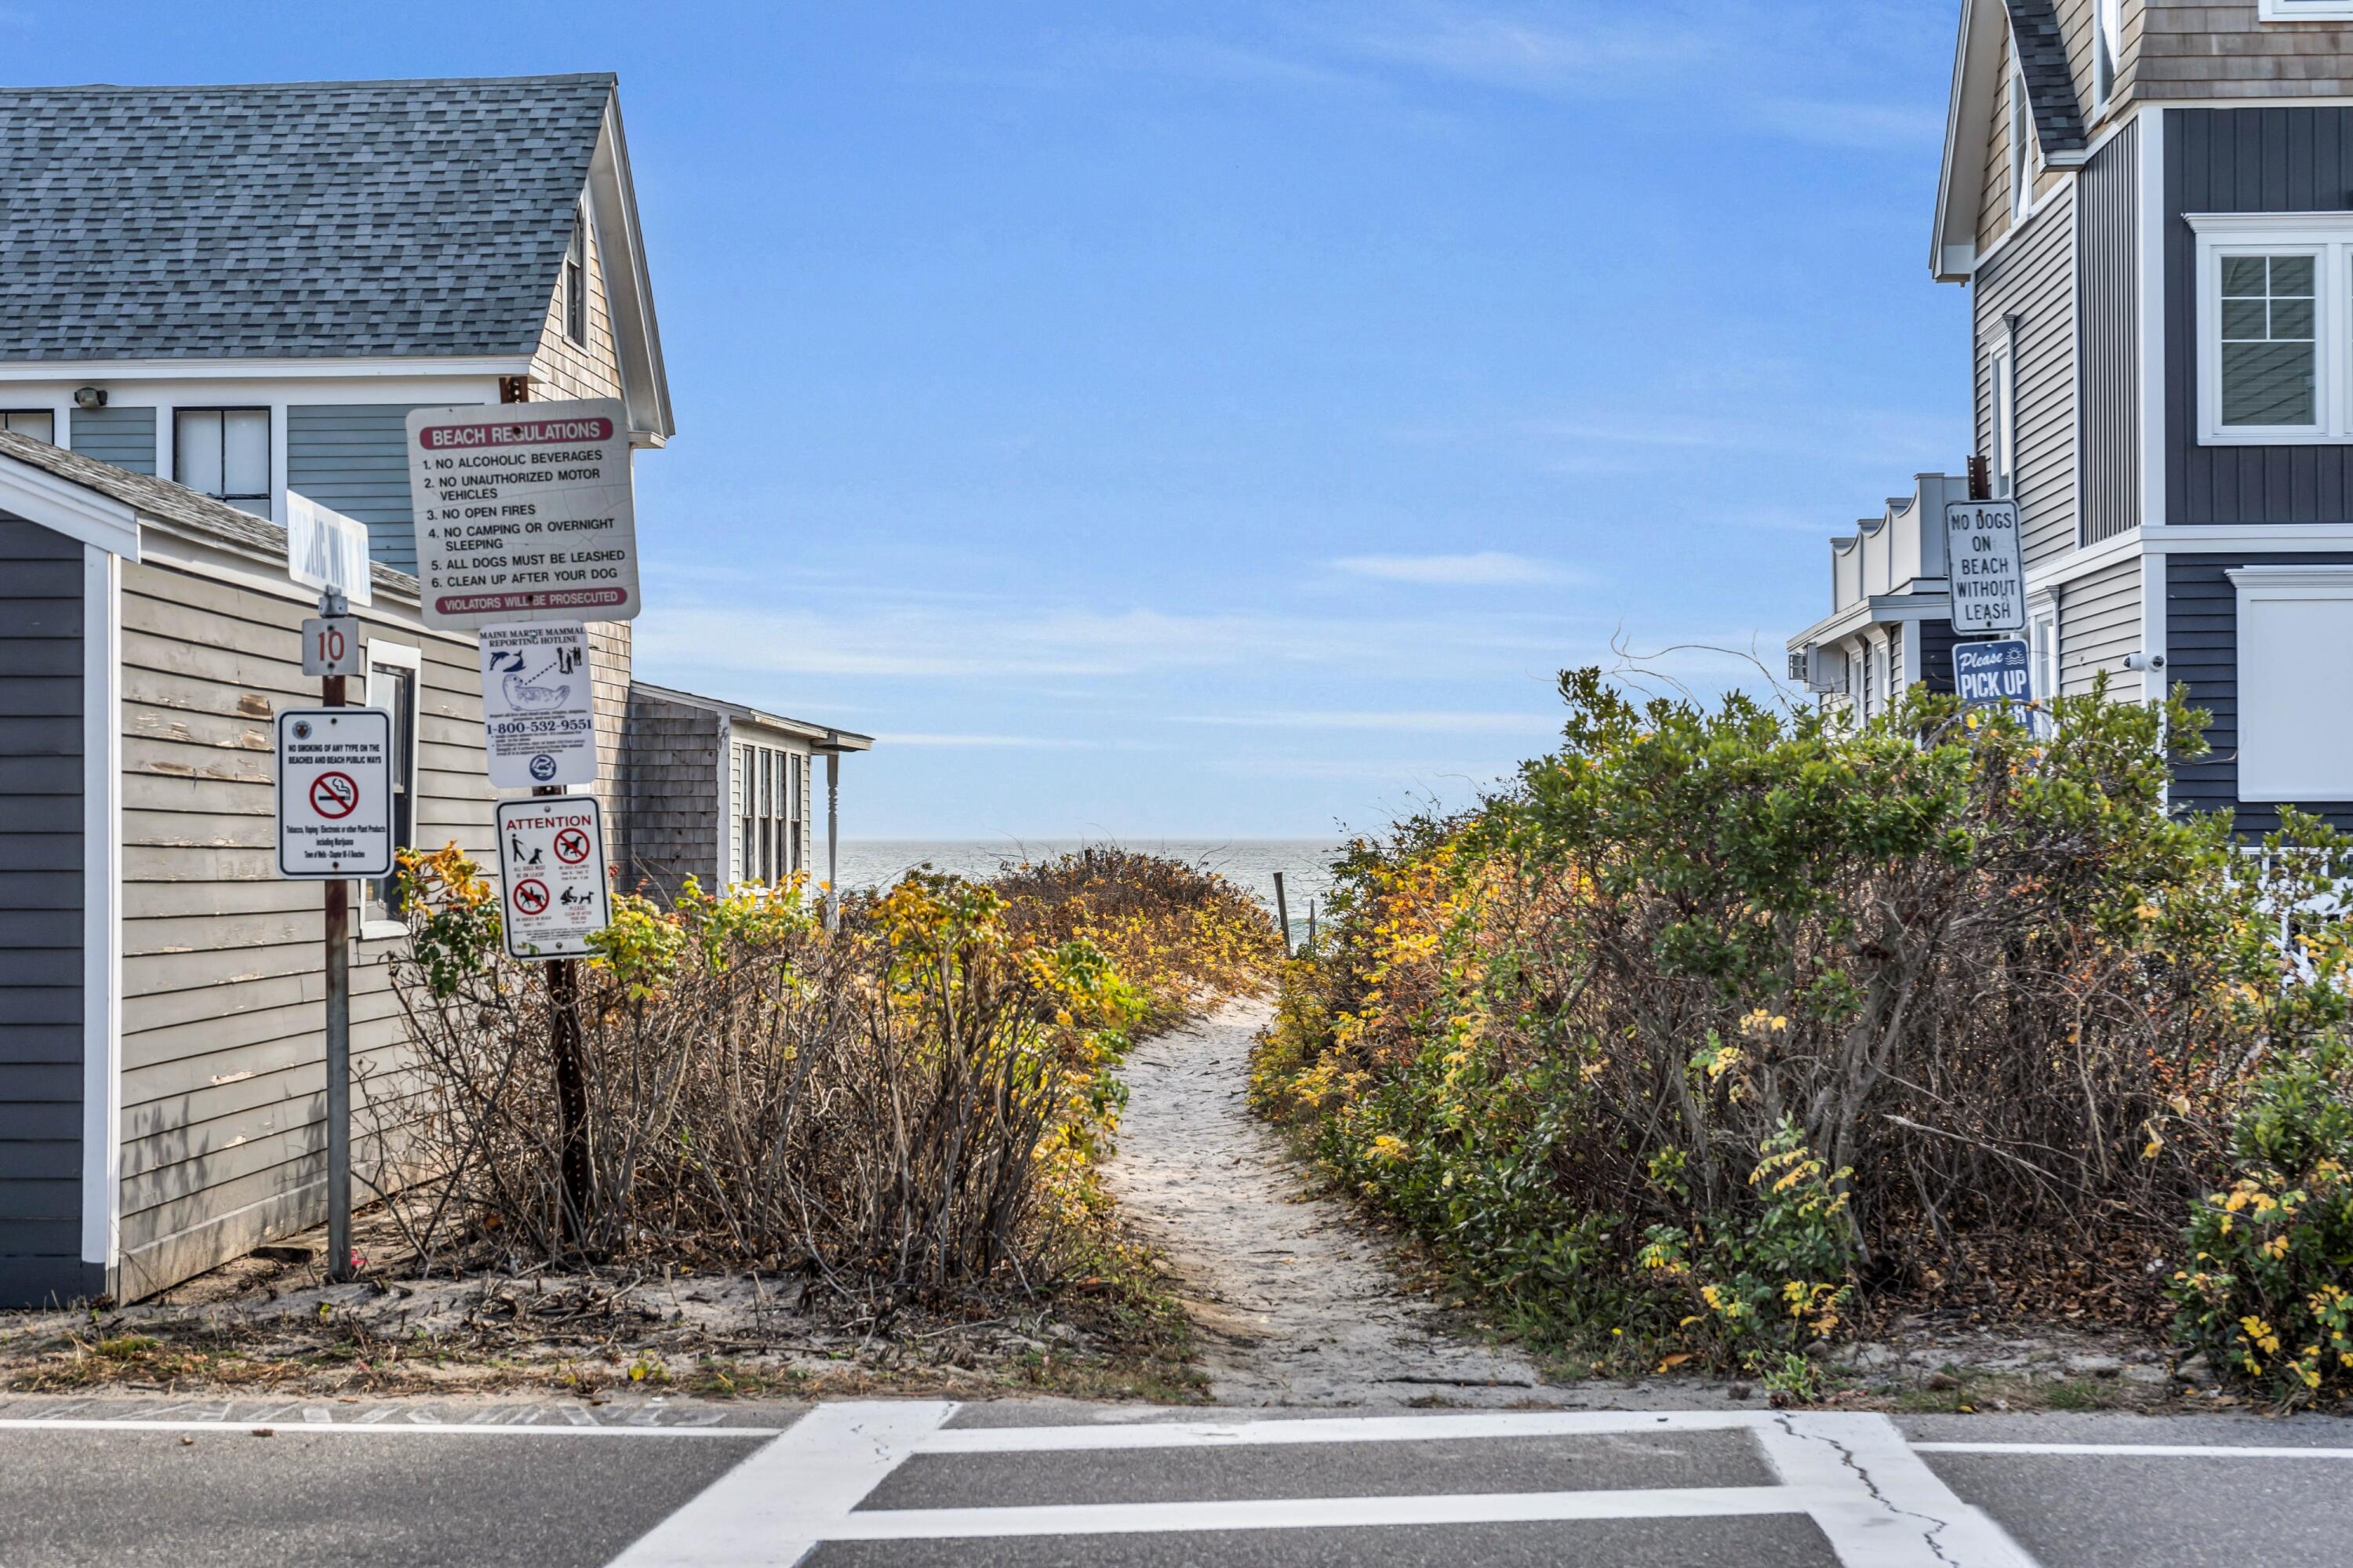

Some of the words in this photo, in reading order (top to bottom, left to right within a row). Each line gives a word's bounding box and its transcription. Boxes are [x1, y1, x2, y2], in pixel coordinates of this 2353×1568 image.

[433, 428, 486, 446] BEACH
[491, 421, 601, 442] REGULATIONS
[423, 461, 431, 470] 1.
[436, 459, 453, 469] NO
[459, 454, 526, 467] ALCOHOLIC
[531, 449, 602, 464] BEVERAGES
[424, 478, 435, 488] 2.
[439, 478, 456, 487] NO
[462, 472, 553, 486] UNAUTHORIZED
[558, 469, 600, 480] MOTOR
[440, 489, 497, 501] VEHICLES
[427, 511, 438, 520] 3.
[442, 510, 460, 519] NO
[465, 507, 497, 518] OPEN
[502, 505, 536, 516] FIRES
[428, 529, 439, 538] 4.
[445, 527, 461, 537] NO
[467, 524, 520, 537] CAMPING
[526, 522, 542, 533] OR
[547, 518, 615, 532] OVERNIGHT
[1951, 515, 1969, 530] NO
[1977, 513, 2012, 529] DOGS
[446, 539, 503, 551] SLEEPING
[1973, 536, 1991, 551] ON
[431, 561, 442, 570] 5.
[447, 559, 467, 569] ALL
[473, 557, 507, 568] DOGS
[512, 555, 544, 566] MUST
[551, 553, 566, 563] BE
[571, 551, 624, 562] LEASHED
[1962, 558, 2009, 575] BEACH
[431, 578, 442, 588] 6.
[447, 576, 486, 588] CLEAN
[491, 575, 506, 585] UP
[511, 572, 549, 584] AFTER
[555, 570, 586, 581] YOUR
[591, 569, 617, 579] DOG
[1957, 580, 2016, 598] WITHOUT
[445, 597, 501, 610] VIOLATORS
[504, 596, 529, 607] WILL
[533, 595, 546, 606] BE
[550, 591, 617, 605] PROSECUTED
[1966, 603, 2010, 620] LEASH
[546, 628, 585, 636] MAMMAL
[318, 631, 344, 661] 10
[489, 638, 539, 647] REPORTING
[540, 636, 577, 645] HOTLINE
[1958, 653, 2003, 671] Please
[1961, 671, 2001, 699] PICK
[2004, 670, 2027, 695] UP
[487, 719, 592, 734] 1-800-532-9551
[506, 815, 591, 831] ATTENTION
